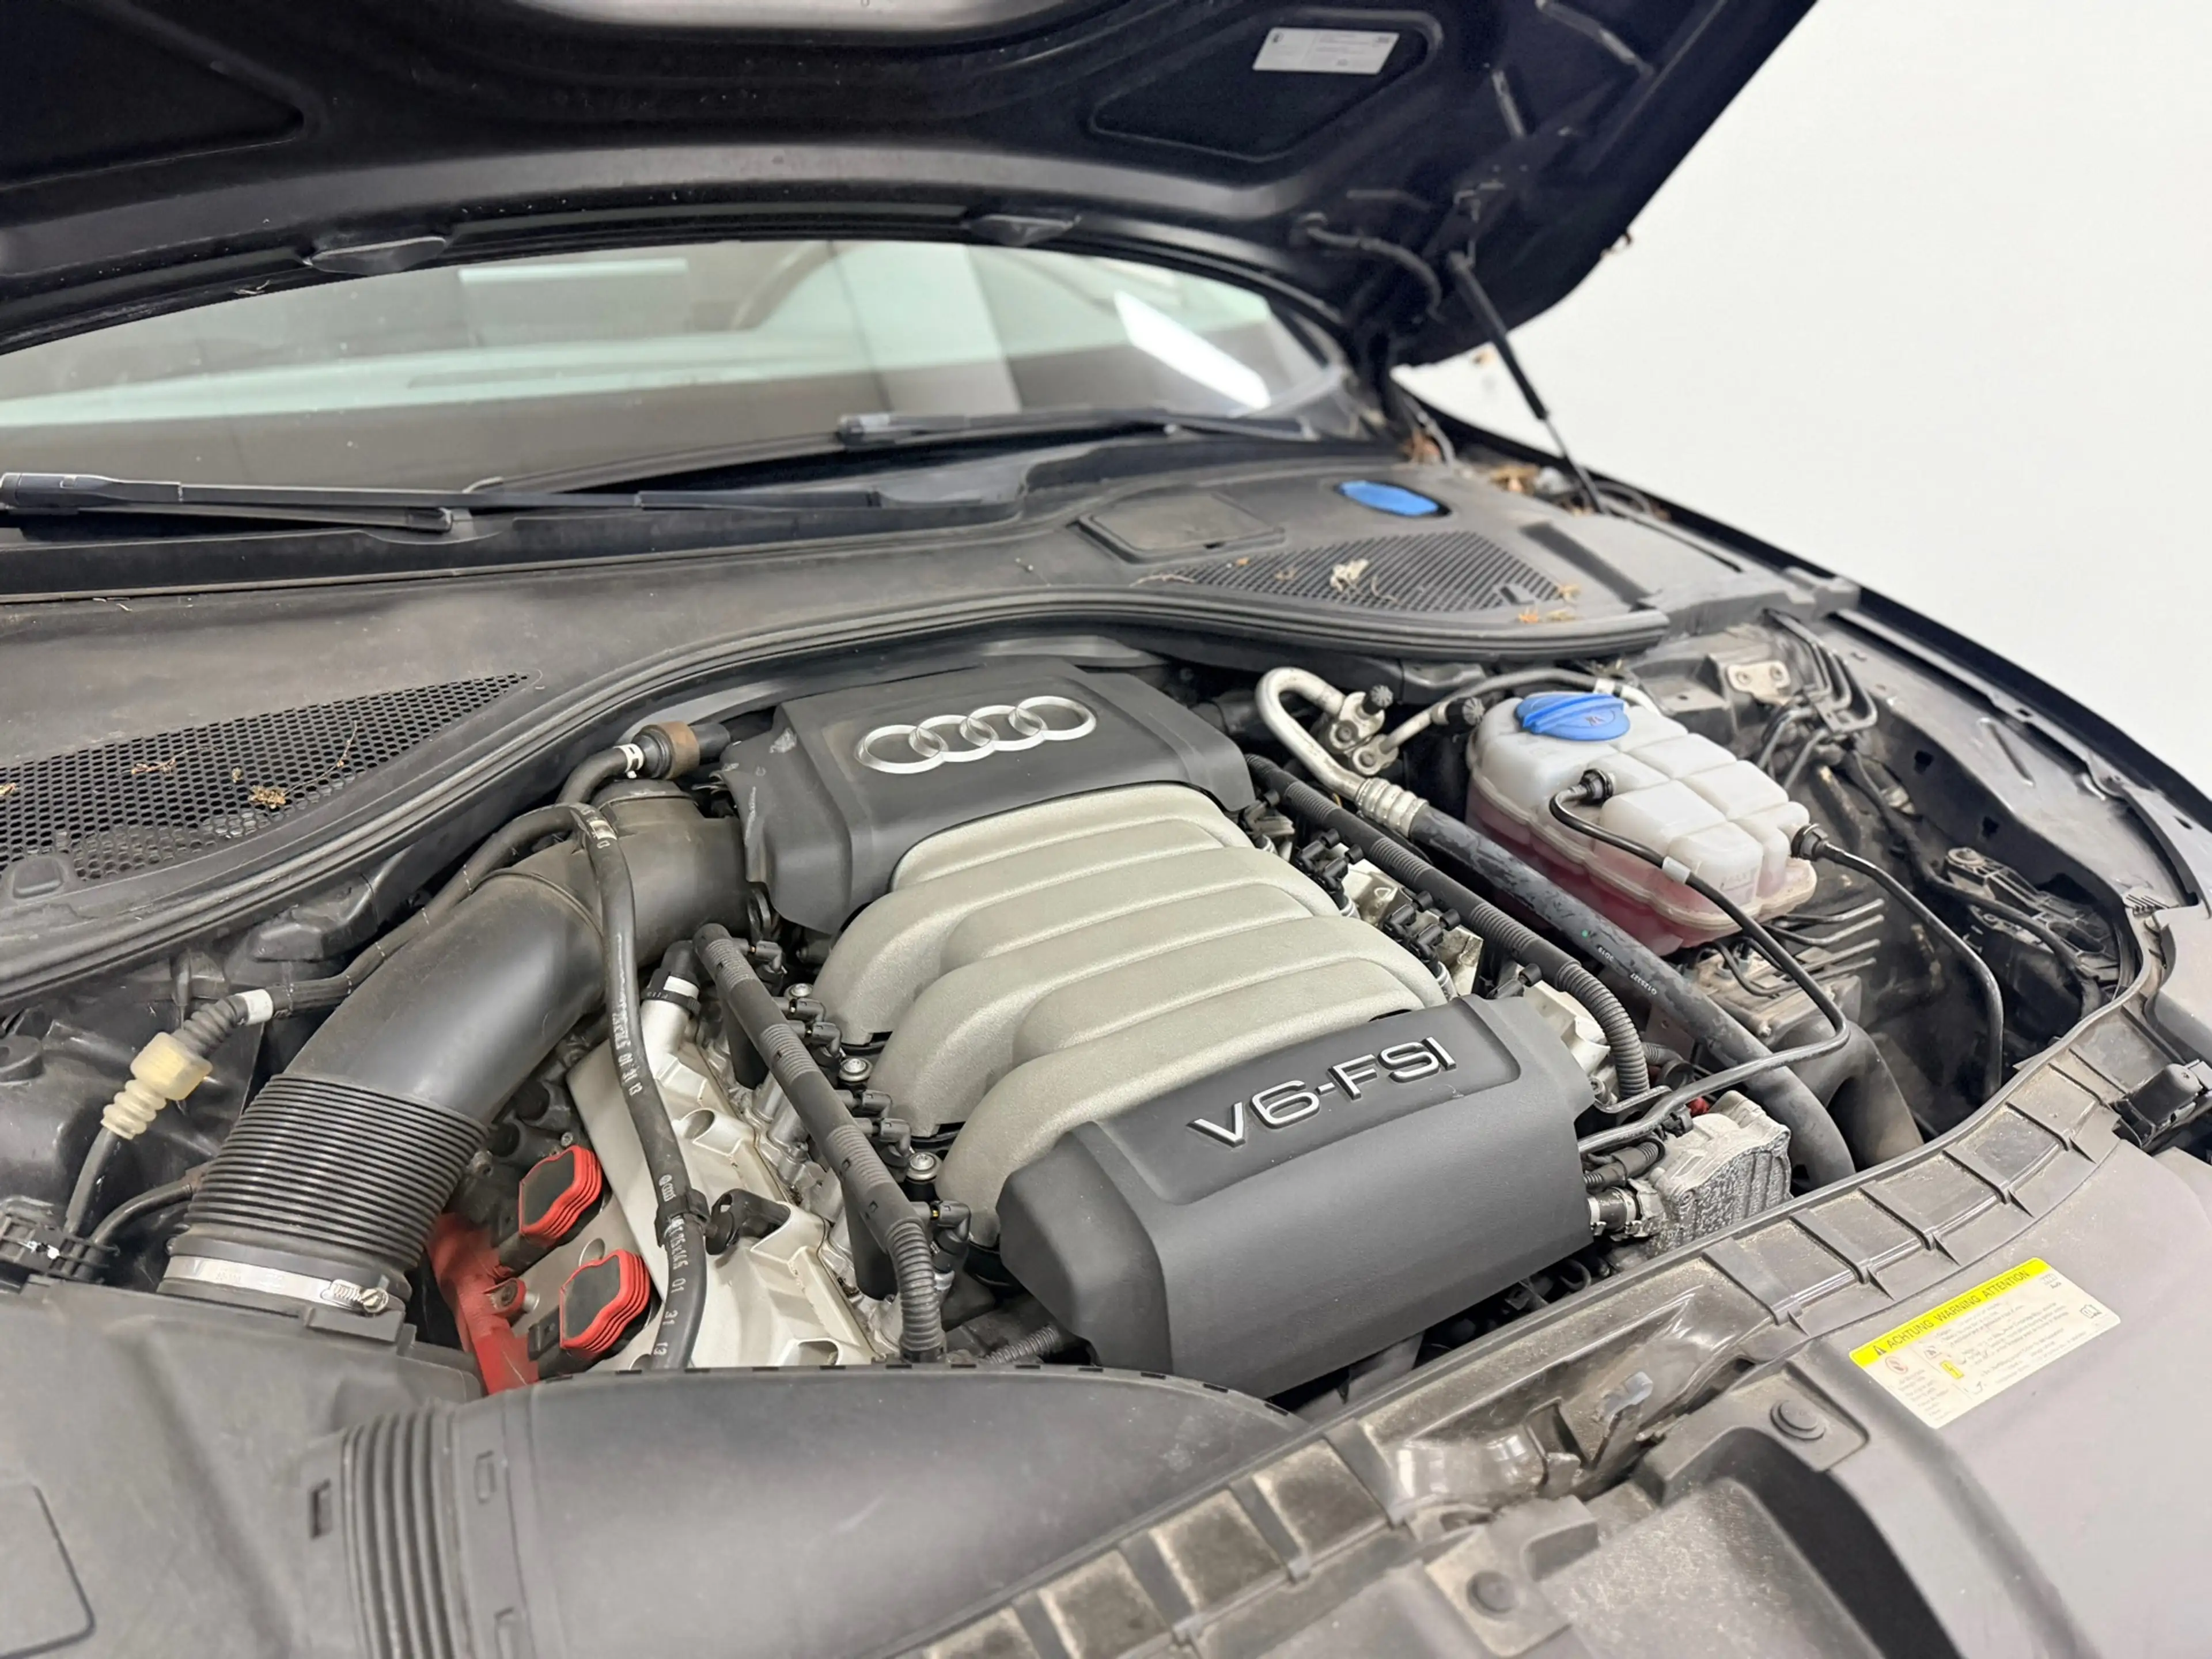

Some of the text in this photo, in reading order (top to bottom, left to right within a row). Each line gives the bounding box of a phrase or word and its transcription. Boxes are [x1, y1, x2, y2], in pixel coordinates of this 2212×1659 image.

[1188, 1037, 1457, 1147] V6-FSI
[671, 1277, 687, 1294] 01
[1886, 1319, 1935, 1349] ACHTUNG
[1933, 1294, 1982, 1323] WARNING
[1980, 1270, 2031, 1300] ATTENTION
[662, 1309, 679, 1325] 31
